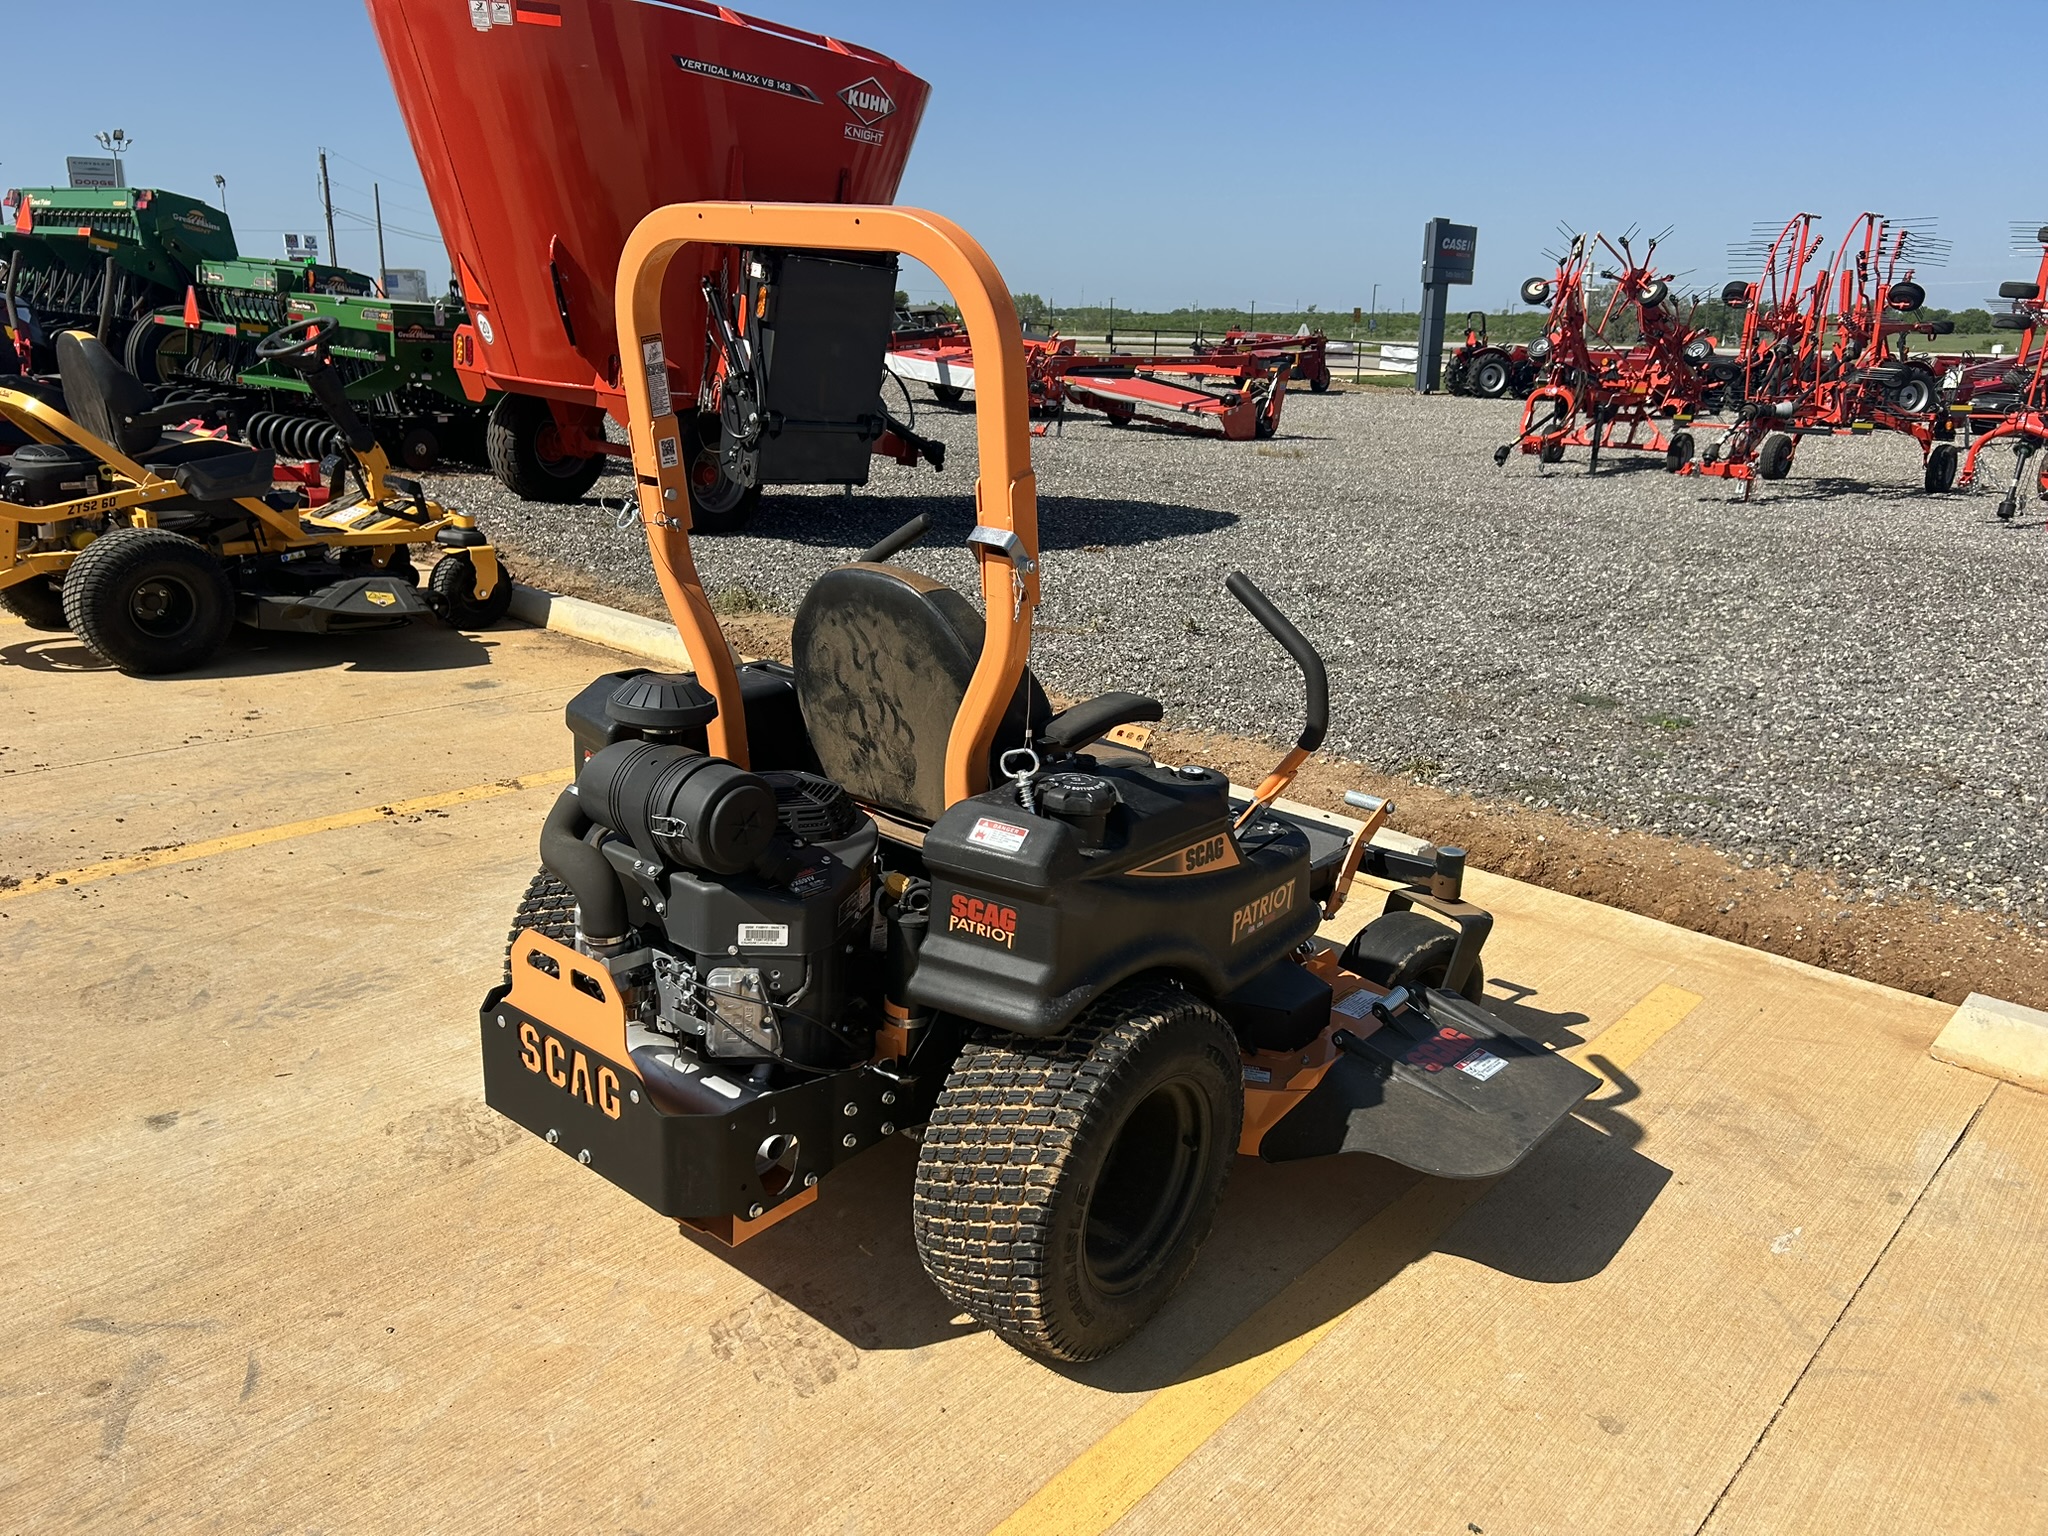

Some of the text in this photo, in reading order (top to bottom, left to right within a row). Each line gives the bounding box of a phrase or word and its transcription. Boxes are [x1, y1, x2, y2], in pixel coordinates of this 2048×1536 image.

[680, 58, 791, 91] VERTICAL MAXX VS 143
[847, 89, 890, 114] KUHN
[844, 125, 884, 143] KNIGHT
[1442, 237, 1467, 251] CASE
[67, 500, 98, 516] ZTS2
[992, 823, 1020, 834] DANGER
[1186, 836, 1224, 872] SCAG
[951, 893, 1018, 932] SCAG
[1231, 877, 1296, 945] PATRIOT
[948, 914, 1016, 950] PATRIOT
[1406, 1027, 1476, 1073] SCAG
[518, 1021, 621, 1120] SCAG
